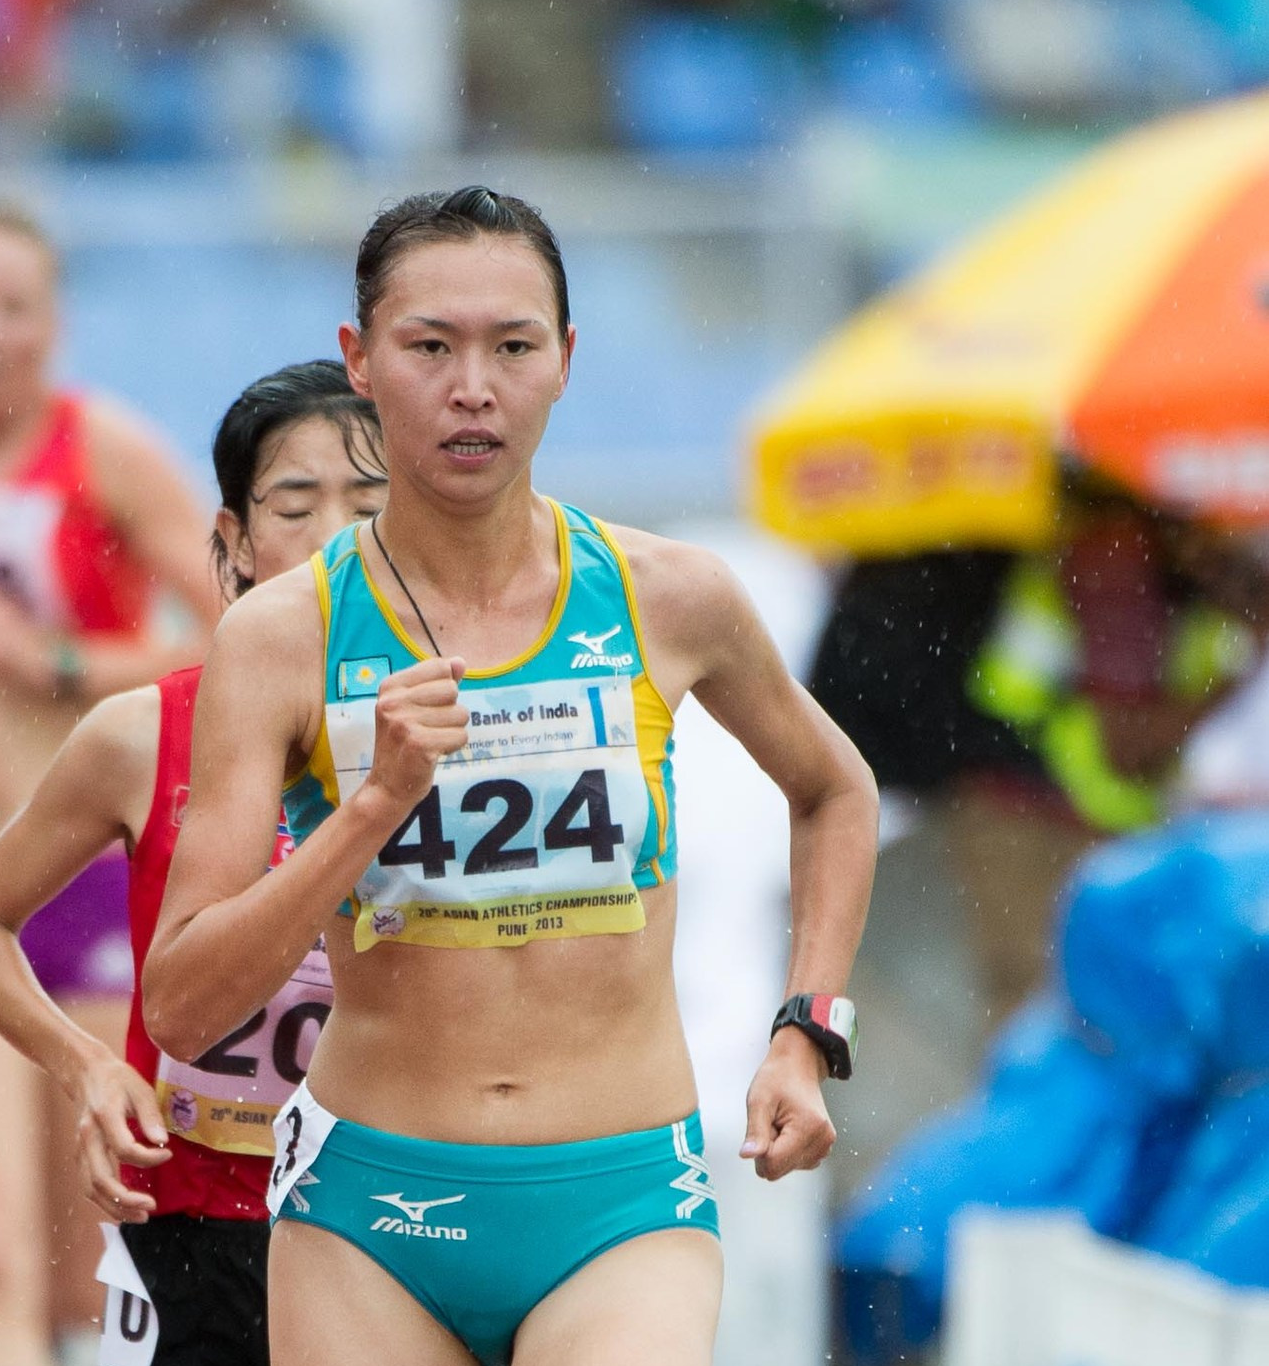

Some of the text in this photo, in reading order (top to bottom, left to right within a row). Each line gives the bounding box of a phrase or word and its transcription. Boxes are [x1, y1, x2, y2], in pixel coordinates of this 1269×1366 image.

[471, 703, 578, 726] Bank of India
[498, 737, 508, 747] to
[511, 734, 541, 746] Every
[544, 731, 574, 742] Indian
[378, 769, 624, 880] 424
[443, 909, 479, 921] ASIAN
[482, 901, 542, 920] ATHLETICS
[497, 917, 563, 936] PUNE 2013
[234, 1110, 268, 1126] ASIAN
[370, 1216, 467, 1241] MIZUNO
